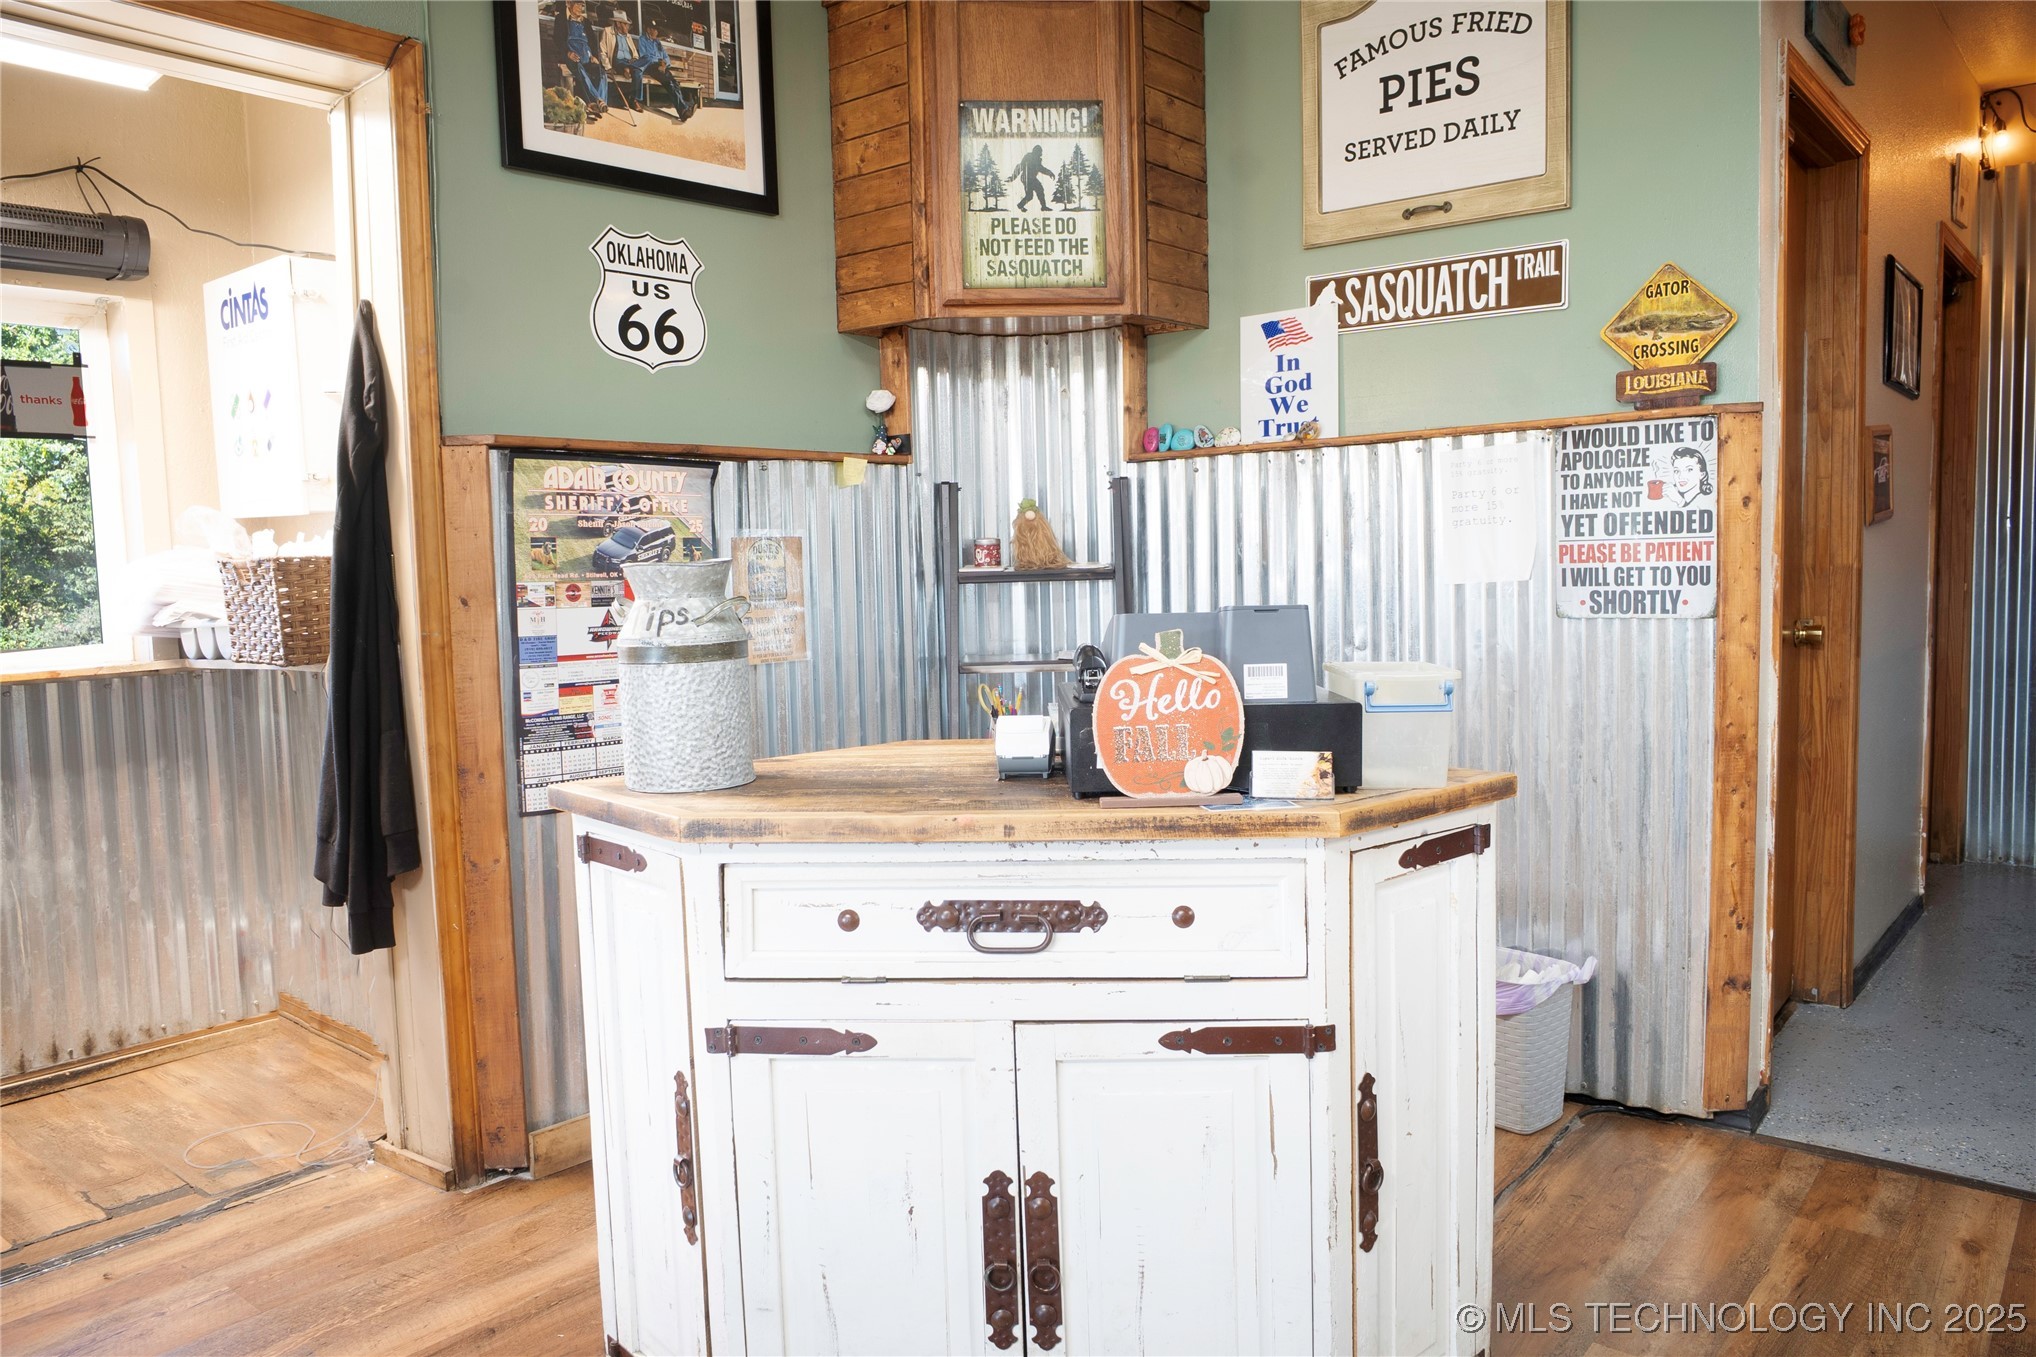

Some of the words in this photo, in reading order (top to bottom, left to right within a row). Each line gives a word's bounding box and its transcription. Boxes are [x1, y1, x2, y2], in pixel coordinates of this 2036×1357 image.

[1334, 17, 1442, 80] FAMOUS
[1451, 11, 1533, 35] FRIED
[1379, 56, 1480, 114] PIES
[972, 107, 1088, 133] WARNING!
[1344, 127, 1436, 162] SERVED
[1443, 109, 1521, 143] DAILY
[991, 217, 1050, 235] PLEASE
[1055, 217, 1076, 235] DO
[980, 238, 1010, 256] NOT
[1015, 238, 1055, 256] FEED
[1058, 238, 1089, 256] THE
[606, 241, 688, 275] OKLAHOMA
[987, 259, 1083, 278] SASQUATCH
[632, 280, 670, 300] US
[1344, 256, 1508, 326] SASQUATCH
[1514, 249, 1559, 280] TRAIL
[1645, 279, 1690, 299] GATOR
[618, 303, 685, 356] 66
[1633, 339, 1699, 359] CROSSING
[1276, 354, 1300, 373] In
[1265, 372, 1312, 394] God
[20, 394, 63, 405] thanks
[1269, 396, 1309, 415] We
[1258, 416, 1319, 437] Tru
[1561, 431, 1568, 450] I
[1571, 425, 1640, 449] WOULD
[1644, 422, 1685, 445] LIKE
[1688, 420, 1714, 442] TO
[1561, 448, 1650, 471] APOLOGIZE
[544, 466, 607, 490] ADAIR
[614, 470, 688, 493] COUNTY
[1561, 474, 1580, 490] TO
[1583, 470, 1644, 489] ANYONE
[1451, 489, 1485, 499] Party
[1505, 487, 1520, 495] or
[1561, 494, 1566, 510] I
[1570, 493, 1608, 510] HAVE
[1612, 491, 1643, 508] NOT
[545, 495, 631, 512] SHERIFF'S
[639, 497, 689, 513] OFFICE
[1451, 504, 1478, 513] more
[528, 517, 548, 532] 20
[689, 519, 704, 533] 25
[1451, 515, 1512, 528] gratuity.
[1561, 513, 1598, 537] YET
[1603, 509, 1713, 536] OFFENDED
[1558, 543, 1617, 564] PLEASE
[1620, 543, 1641, 562] BE
[1645, 541, 1714, 562] PATIENT
[1561, 568, 1566, 587] I
[1570, 566, 1610, 587] WILL
[1614, 566, 1645, 587] GET
[1650, 566, 1672, 587] TO
[1675, 565, 1711, 587] YOU
[1589, 590, 1681, 615] SHORTLY
[1110, 673, 1221, 721] Hello
[1113, 724, 1197, 762] FALL
